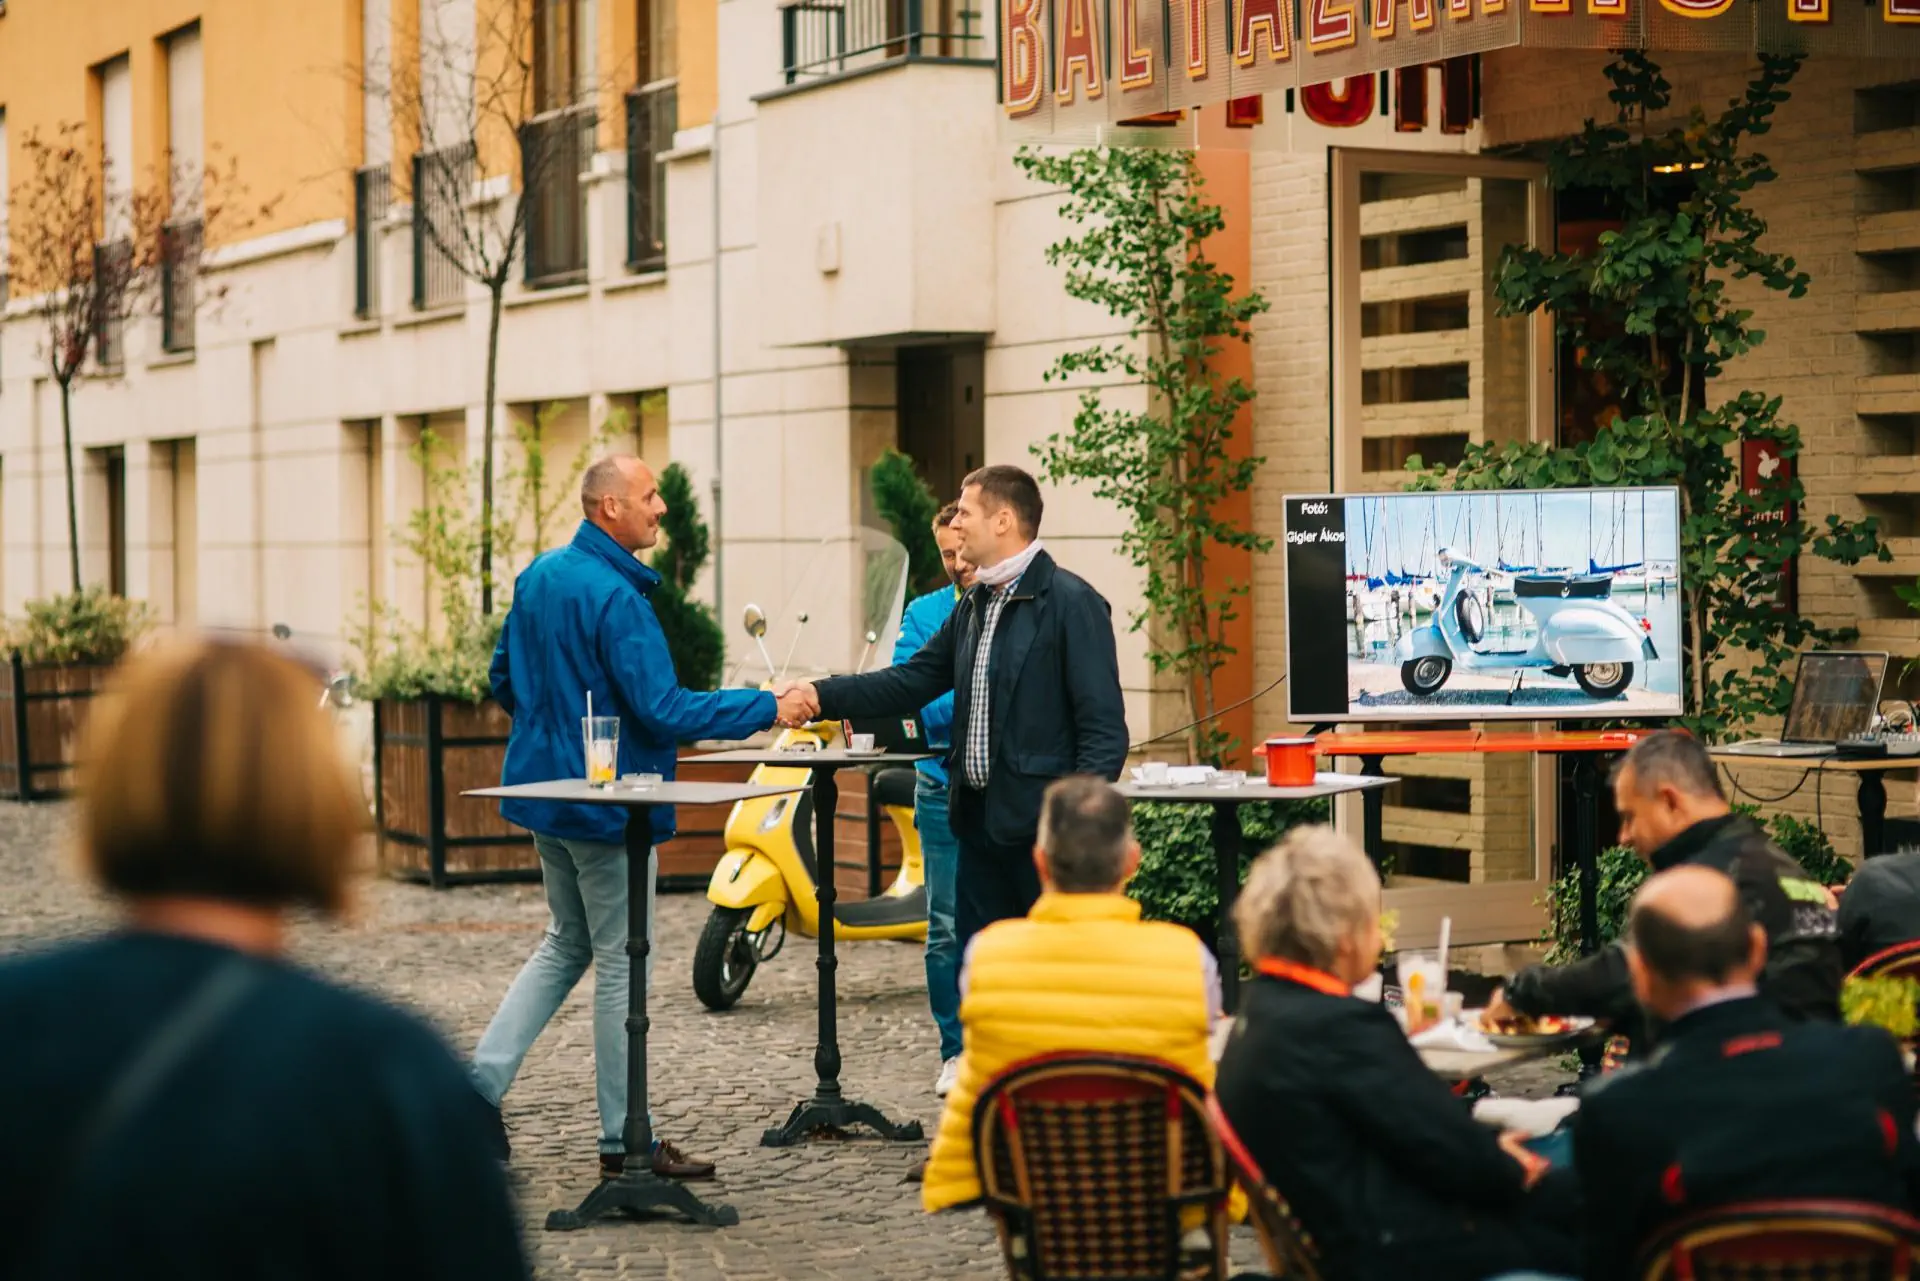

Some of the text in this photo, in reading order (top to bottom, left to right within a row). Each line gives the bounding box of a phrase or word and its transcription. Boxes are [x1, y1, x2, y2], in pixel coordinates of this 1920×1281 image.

[1301, 501, 1328, 515] Fotó:
[1287, 526, 1345, 545] Gigler Ákos
